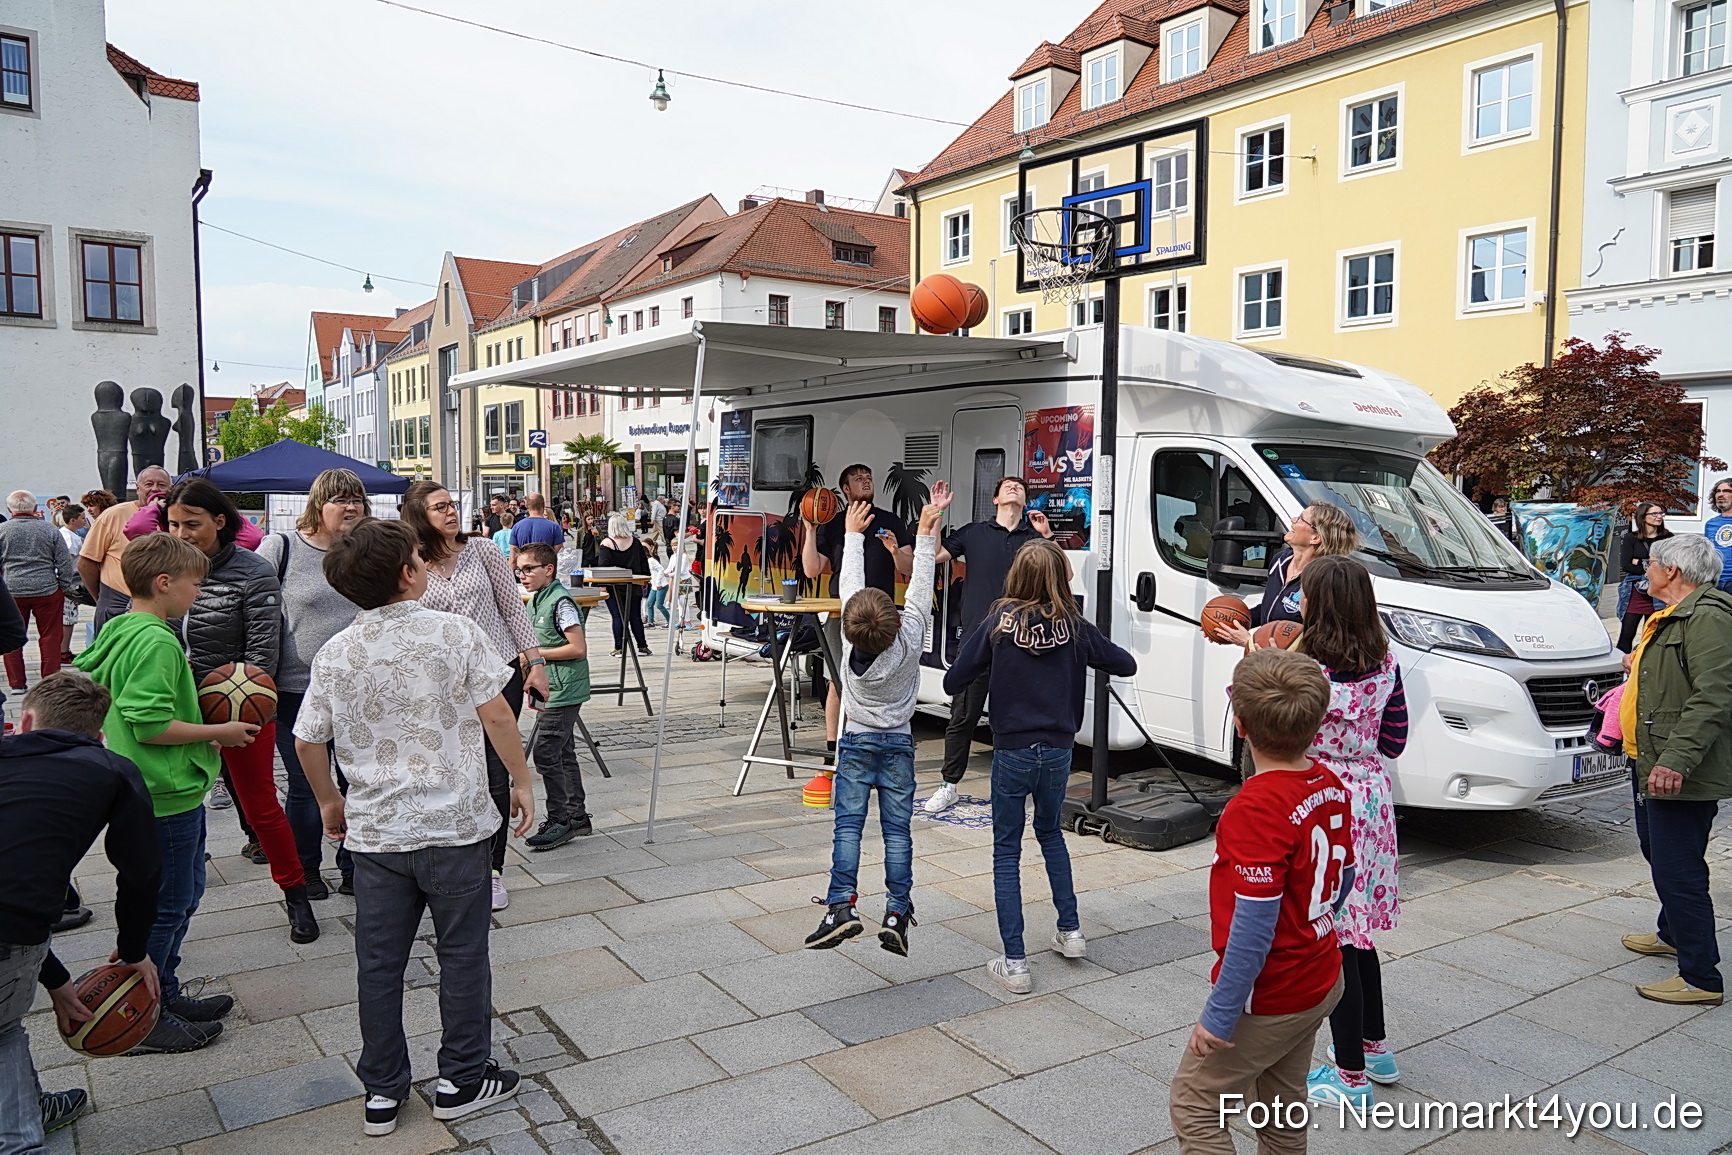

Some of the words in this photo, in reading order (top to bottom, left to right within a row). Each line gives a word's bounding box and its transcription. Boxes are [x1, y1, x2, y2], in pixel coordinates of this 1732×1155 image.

[1155, 241, 1191, 256] SPALDING
[1041, 412, 1079, 424] UPCOMING
[629, 423, 668, 437] Buchhandlung
[1048, 423, 1069, 432] GAME
[1048, 456, 1068, 474] VS
[1056, 499, 1065, 507] MAI
[1514, 634, 1544, 643] trend
[1581, 757, 1592, 774] NM
[1597, 755, 1607, 772] NA
[1235, 865, 1272, 876] QATAR
[83, 972, 119, 1004] molte
